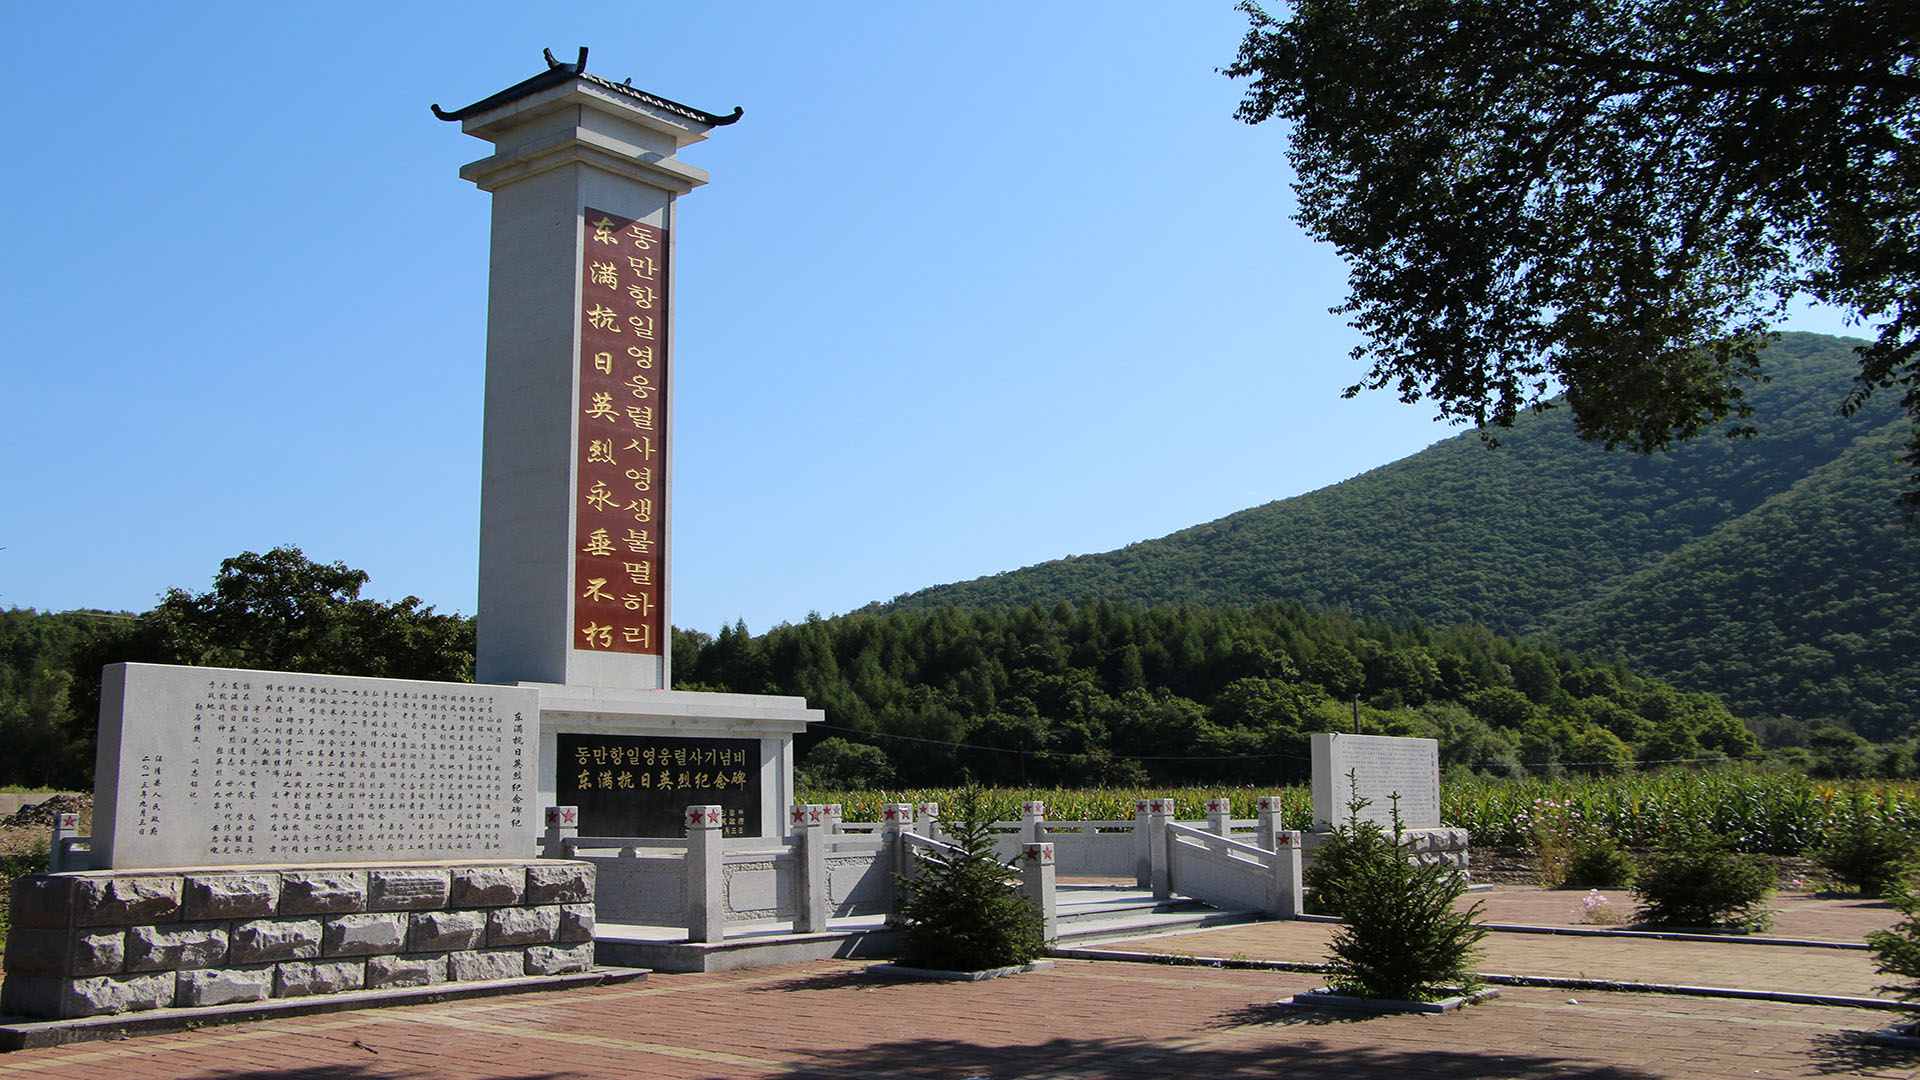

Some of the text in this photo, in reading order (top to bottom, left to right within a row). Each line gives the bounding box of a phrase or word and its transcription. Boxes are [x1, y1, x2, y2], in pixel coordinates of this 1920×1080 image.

[582, 217, 622, 648] 东满抗日英烈永垂不朽
[577, 769, 747, 791] 东满抗日英烈纪念碑
